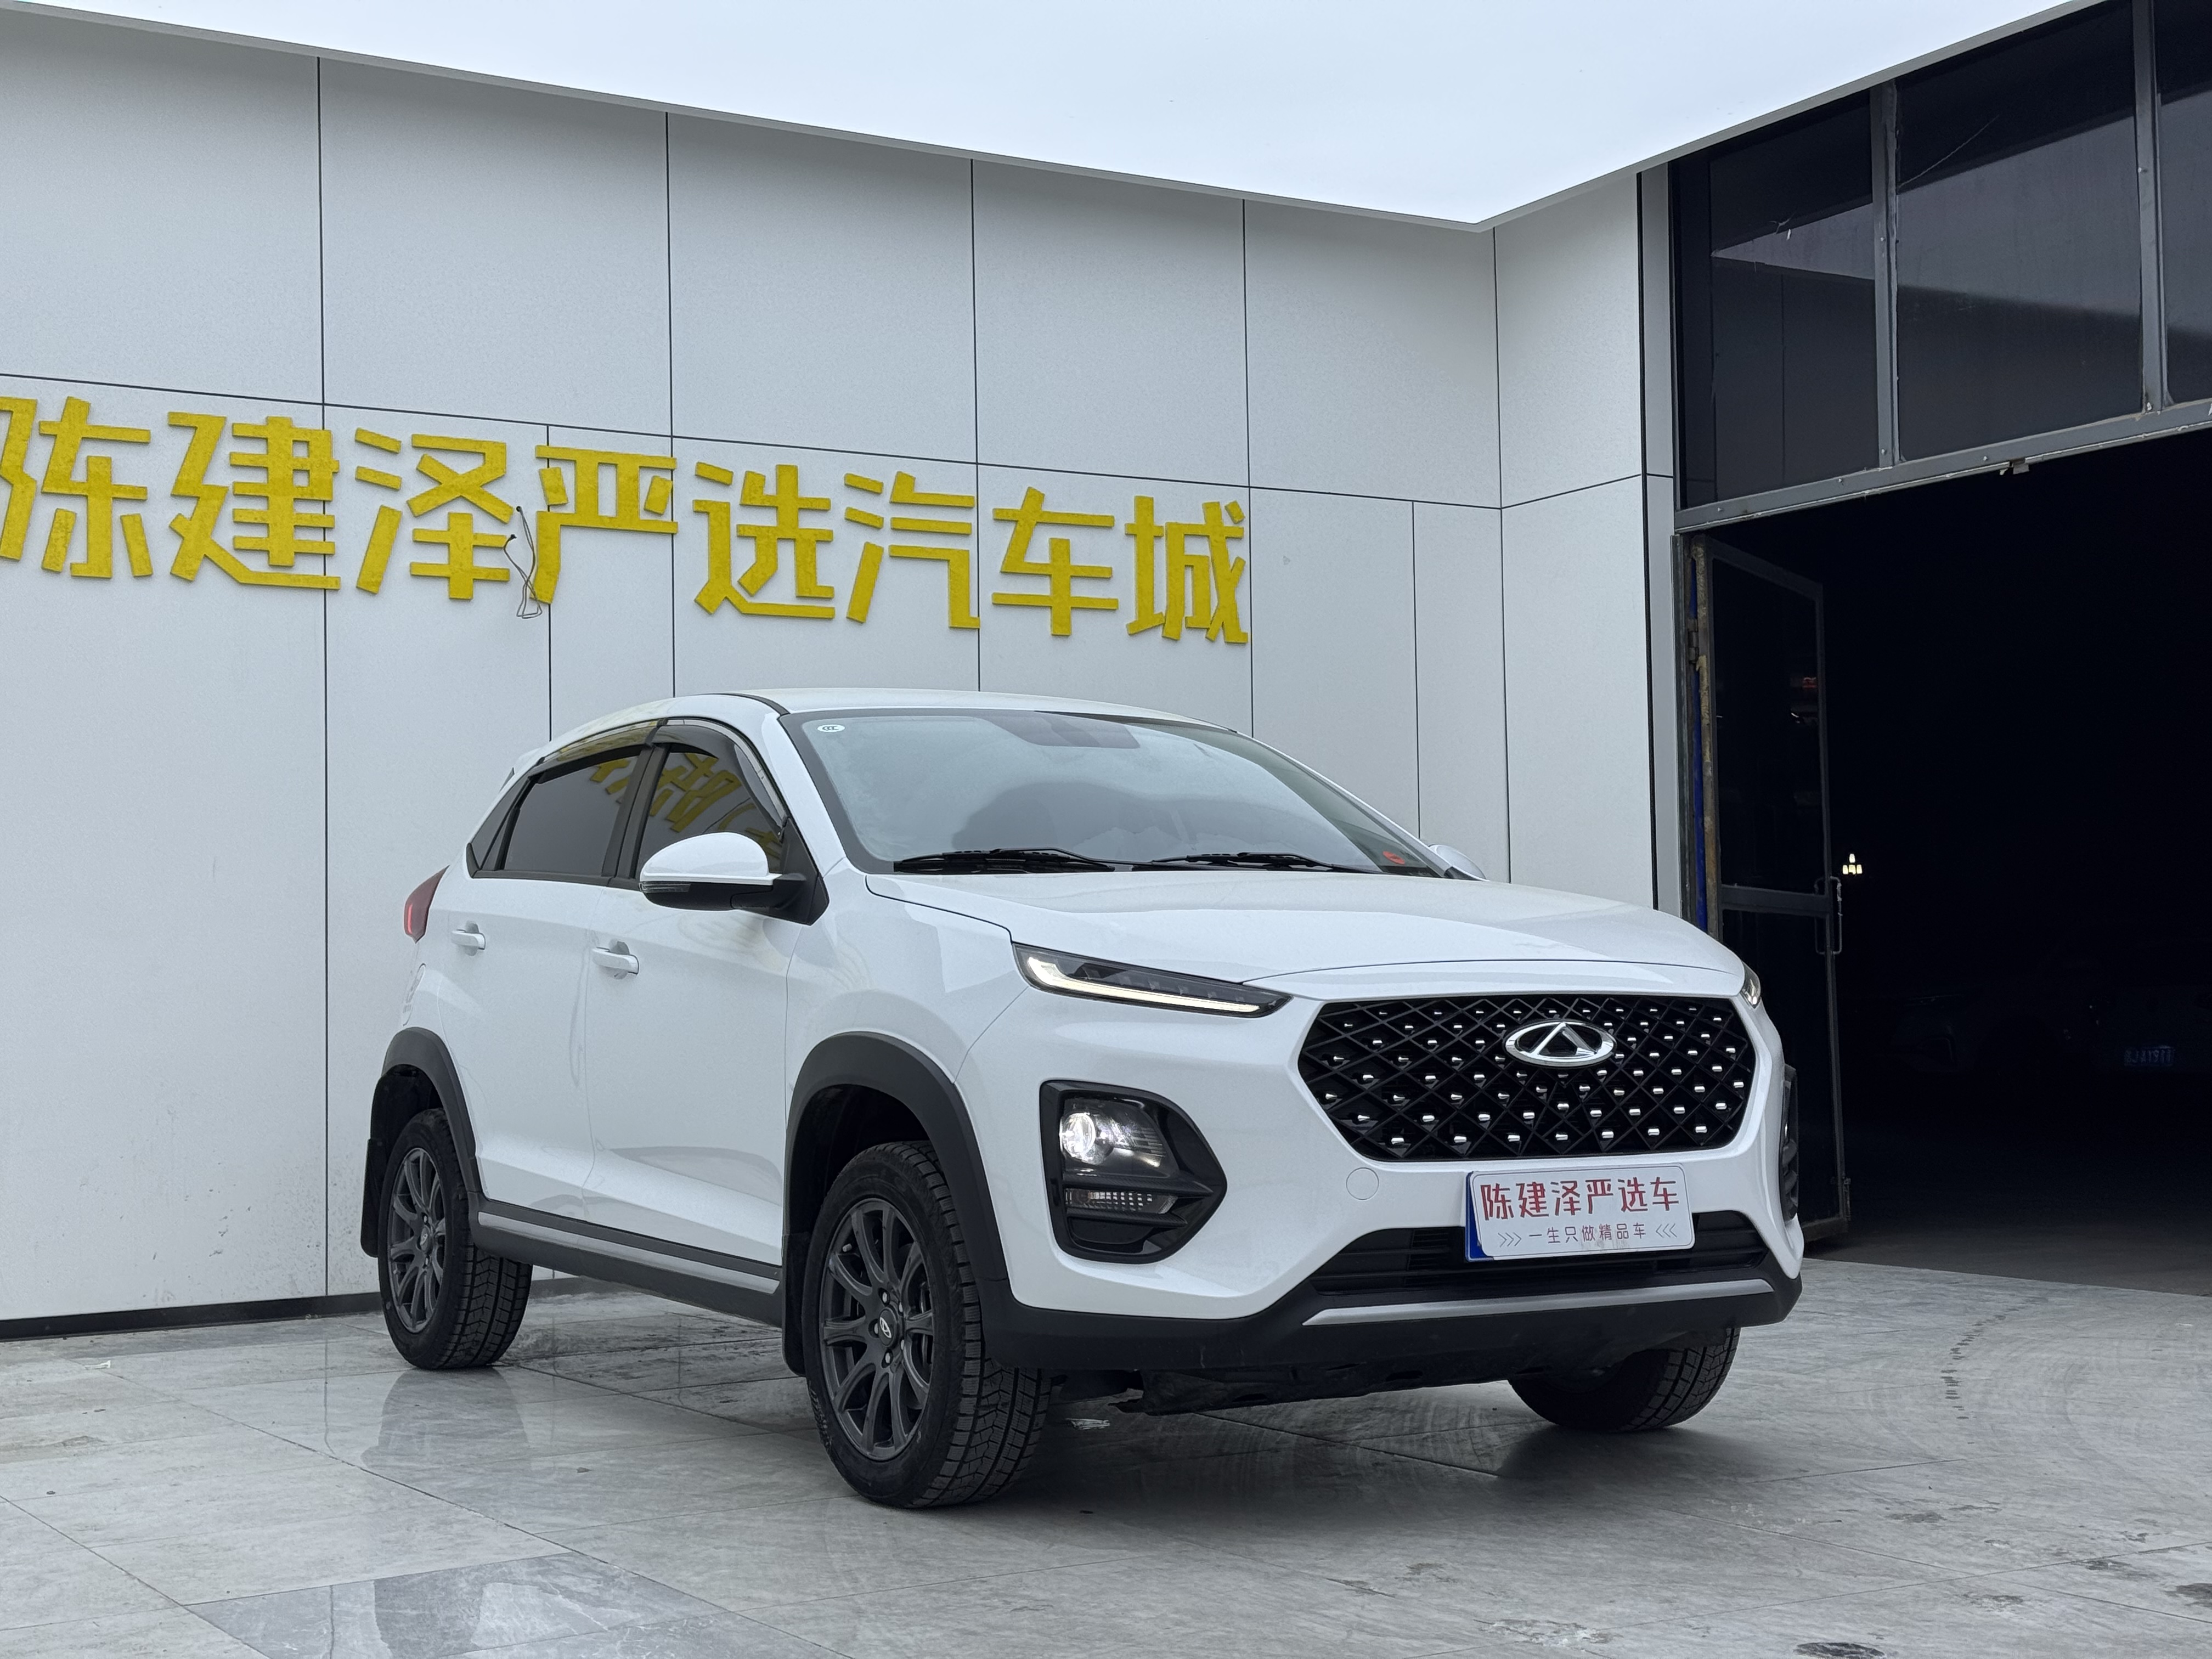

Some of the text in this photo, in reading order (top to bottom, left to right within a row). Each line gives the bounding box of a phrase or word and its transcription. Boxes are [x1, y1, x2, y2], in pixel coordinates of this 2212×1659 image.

[0, 396, 1249, 644] 陈建泽严选汽车城
[1480, 1176, 1680, 1221] 陈建泽严选车
[1528, 1222, 1646, 1245] 一生只做精品车
